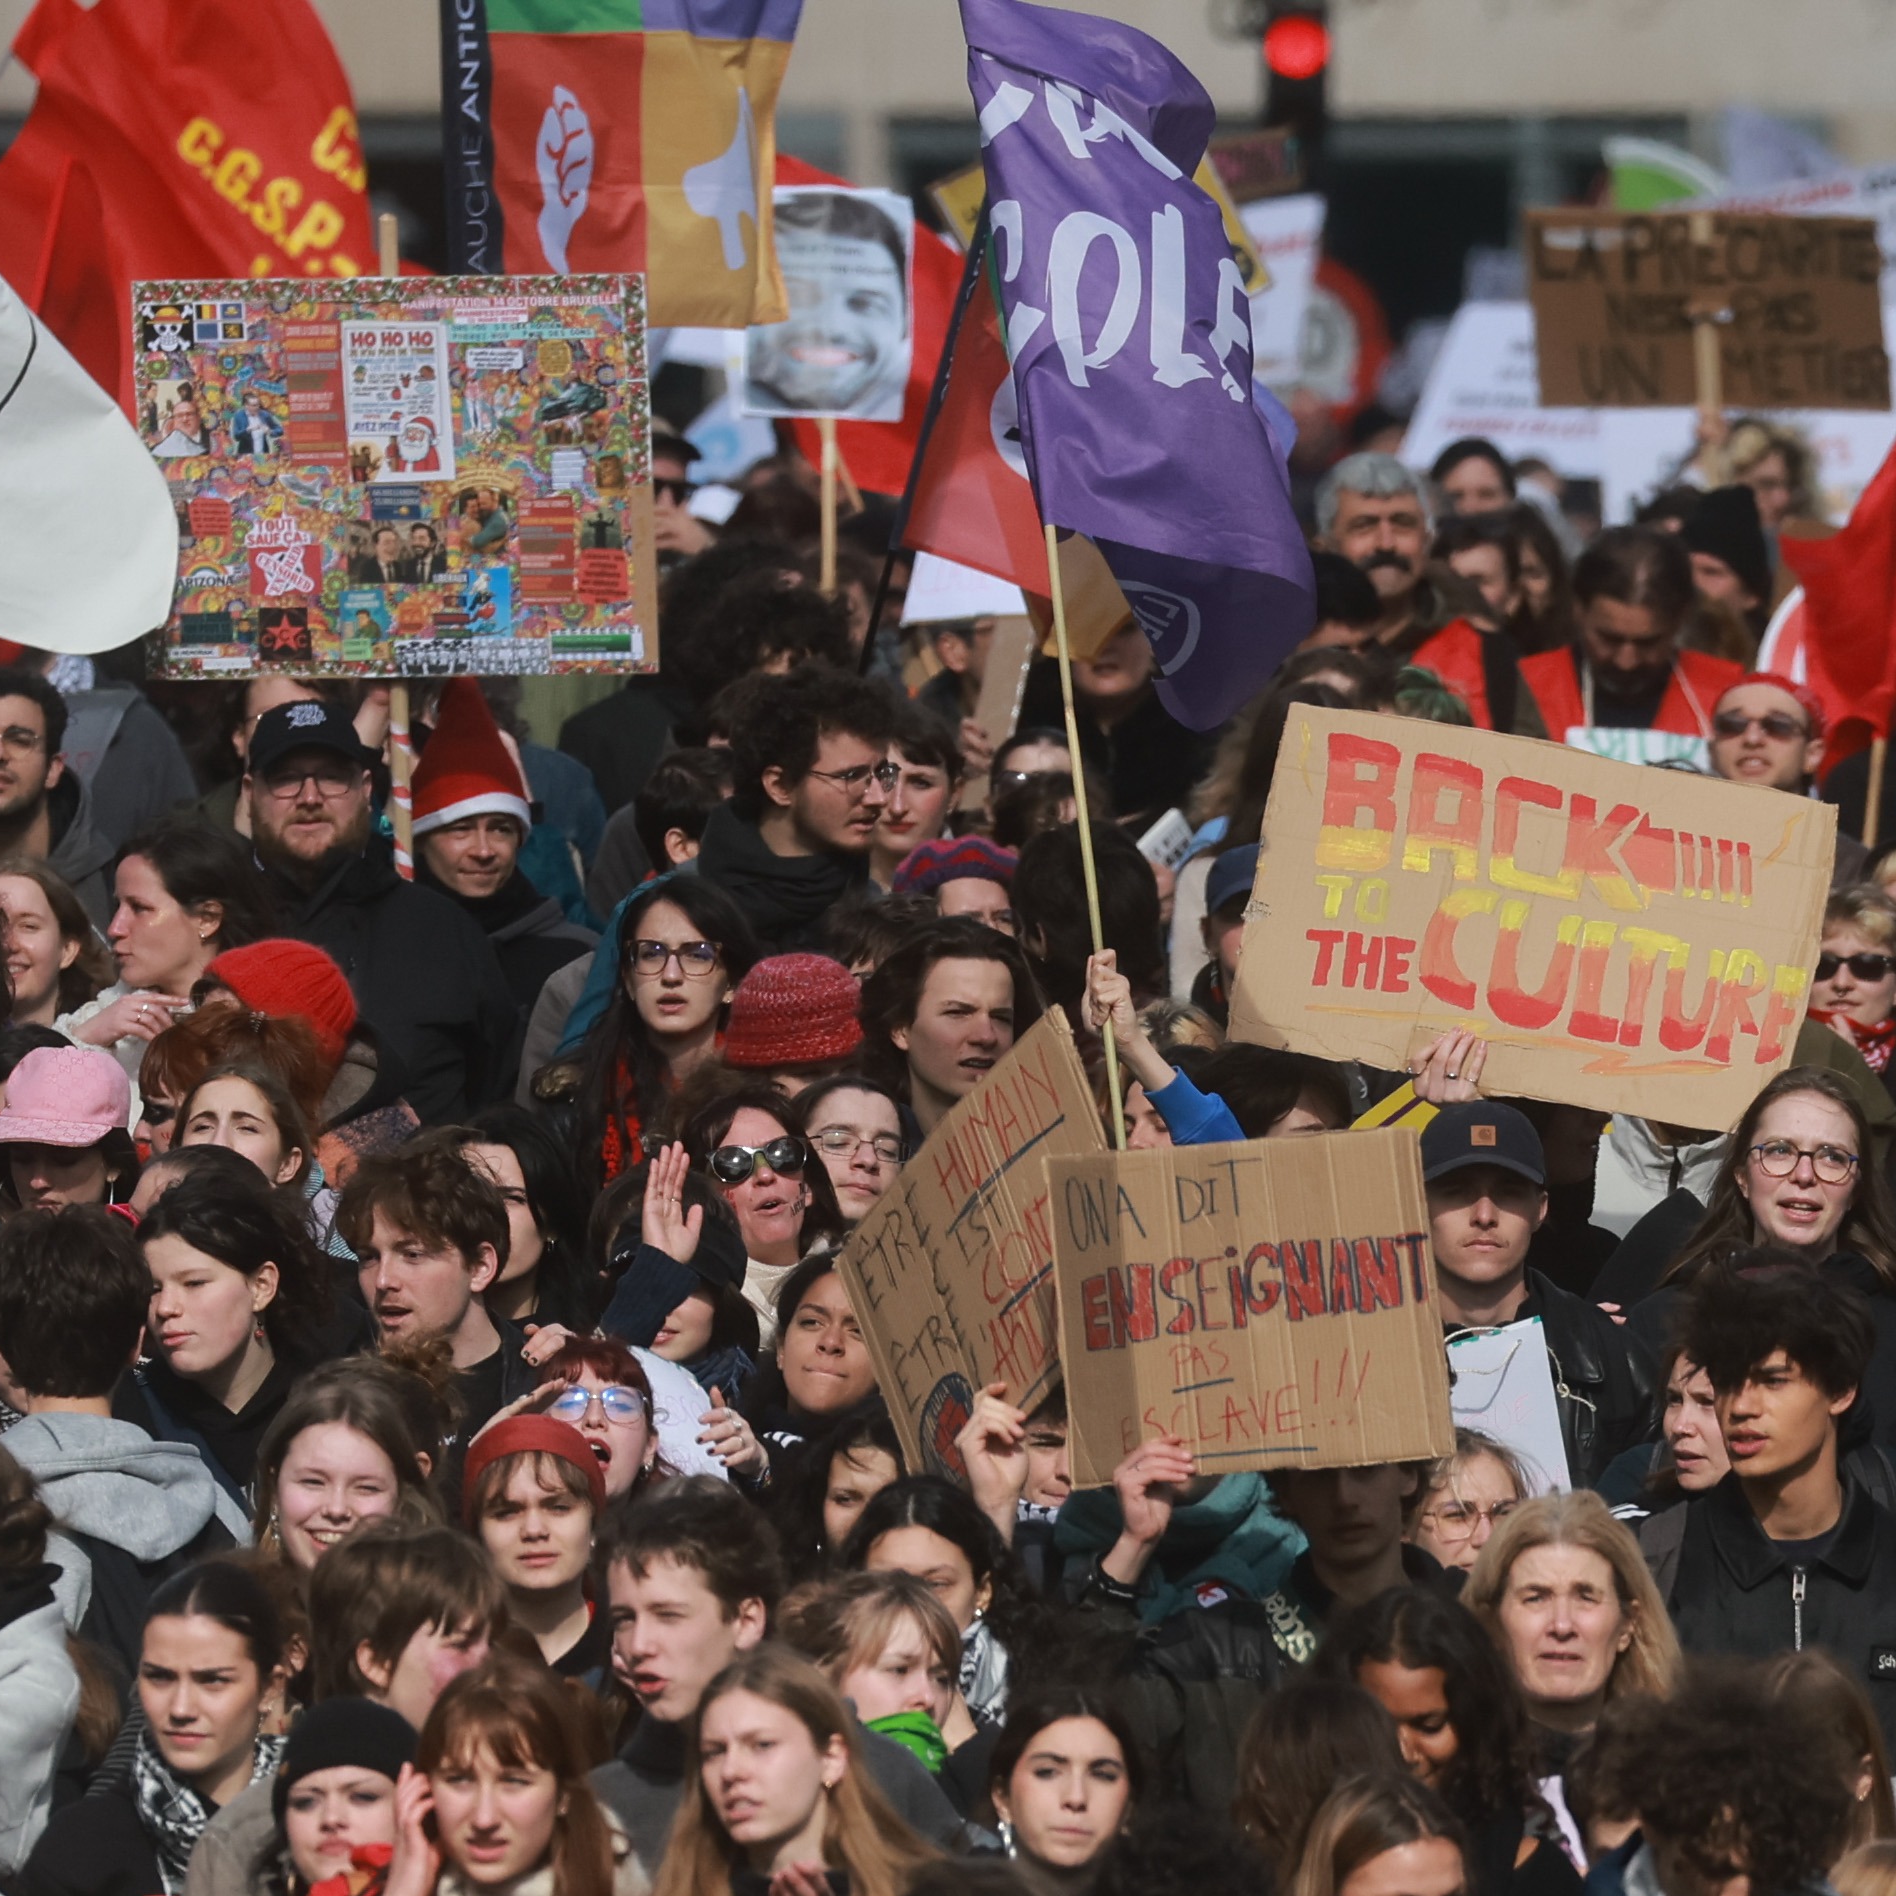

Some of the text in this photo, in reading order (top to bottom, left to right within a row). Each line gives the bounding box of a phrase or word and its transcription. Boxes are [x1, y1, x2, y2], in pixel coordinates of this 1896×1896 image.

[506, 296, 560, 308] OCTOBRE
[350, 331, 376, 347] HO
[381, 331, 404, 347] HO
[408, 330, 434, 347] HO
[246, 533, 281, 547] SAUF
[257, 520, 294, 533] TOUT
[1315, 874, 1392, 926] TO
[1305, 888, 1810, 1065] THE CULTURE
[1175, 1157, 1264, 1225] DIT
[1168, 1338, 1232, 1388] PAS
